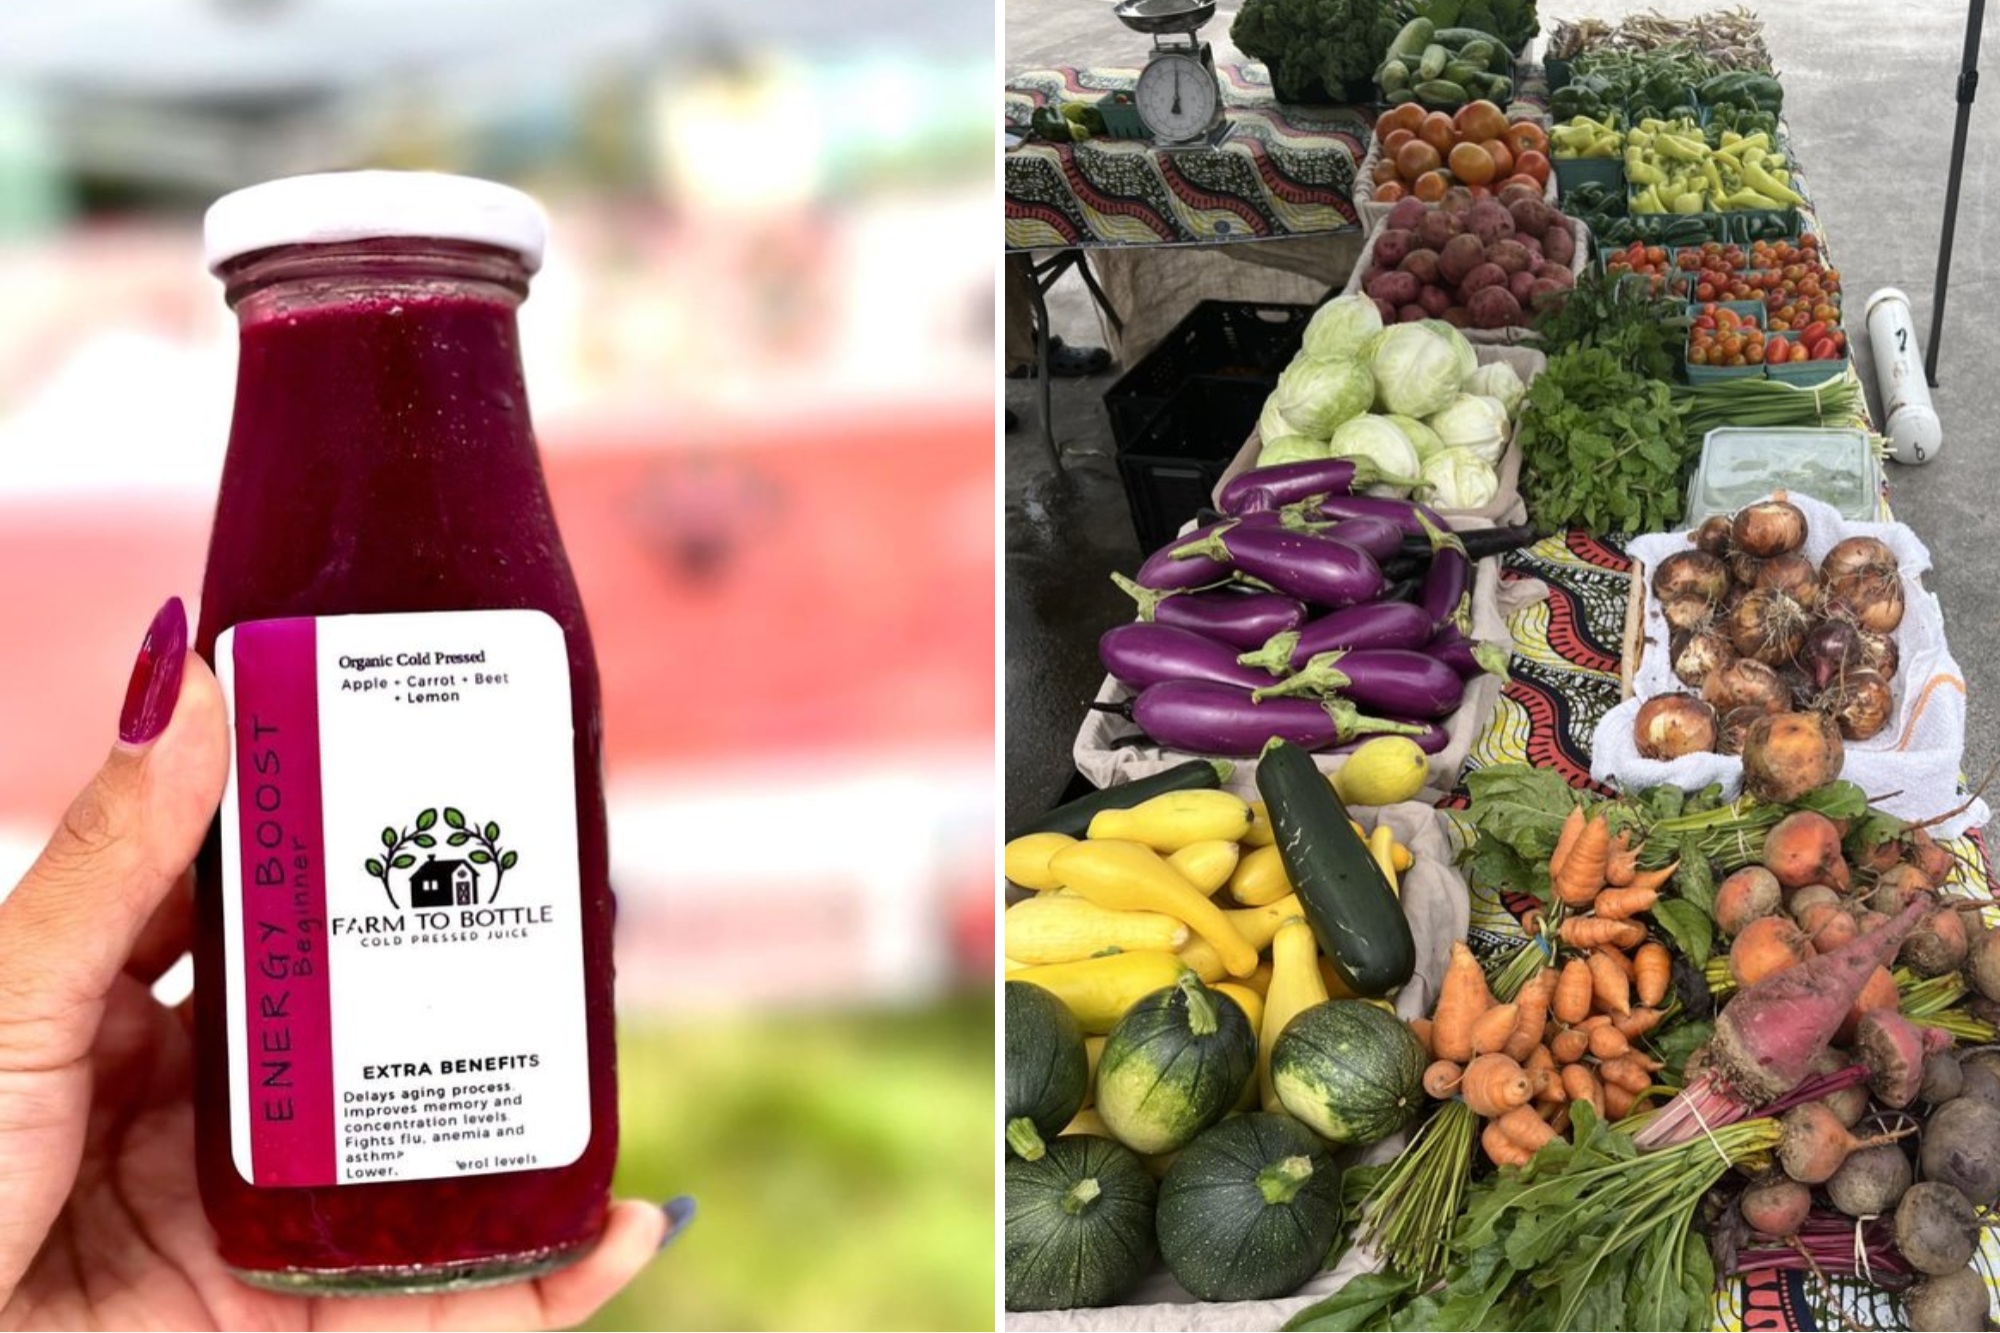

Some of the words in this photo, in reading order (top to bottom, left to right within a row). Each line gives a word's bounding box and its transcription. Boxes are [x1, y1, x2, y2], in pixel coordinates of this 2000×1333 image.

[338, 654, 393, 671] Organic
[396, 652, 431, 667] Cold
[435, 650, 486, 666] Pressed
[341, 677, 388, 692] Apple
[406, 675, 456, 688] Carrot
[474, 673, 509, 685] Beet
[407, 691, 460, 704] Lemon
[253, 715, 285, 886] BOOST
[292, 836, 324, 977] Beginner
[332, 915, 405, 936] FARM
[415, 911, 450, 931] TO
[460, 905, 553, 929] BOTTLE
[360, 936, 402, 947] COLD
[411, 931, 478, 944] PRESSED
[488, 927, 528, 940] JUICE
[258, 921, 294, 1122] ENERGY
[363, 1062, 433, 1080] EXTRA
[440, 1054, 540, 1075] BENEFITS
[344, 1090, 395, 1104] Delays
[401, 1087, 446, 1101] aging
[344, 1104, 418, 1119] Improves
[424, 1099, 488, 1113] memory
[494, 1094, 522, 1108] and
[344, 1116, 457, 1134] concentration
[345, 1135, 395, 1150] Fights
[432, 1127, 490, 1142] anemia
[496, 1123, 524, 1137] and
[494, 1152, 537, 1167] levels
